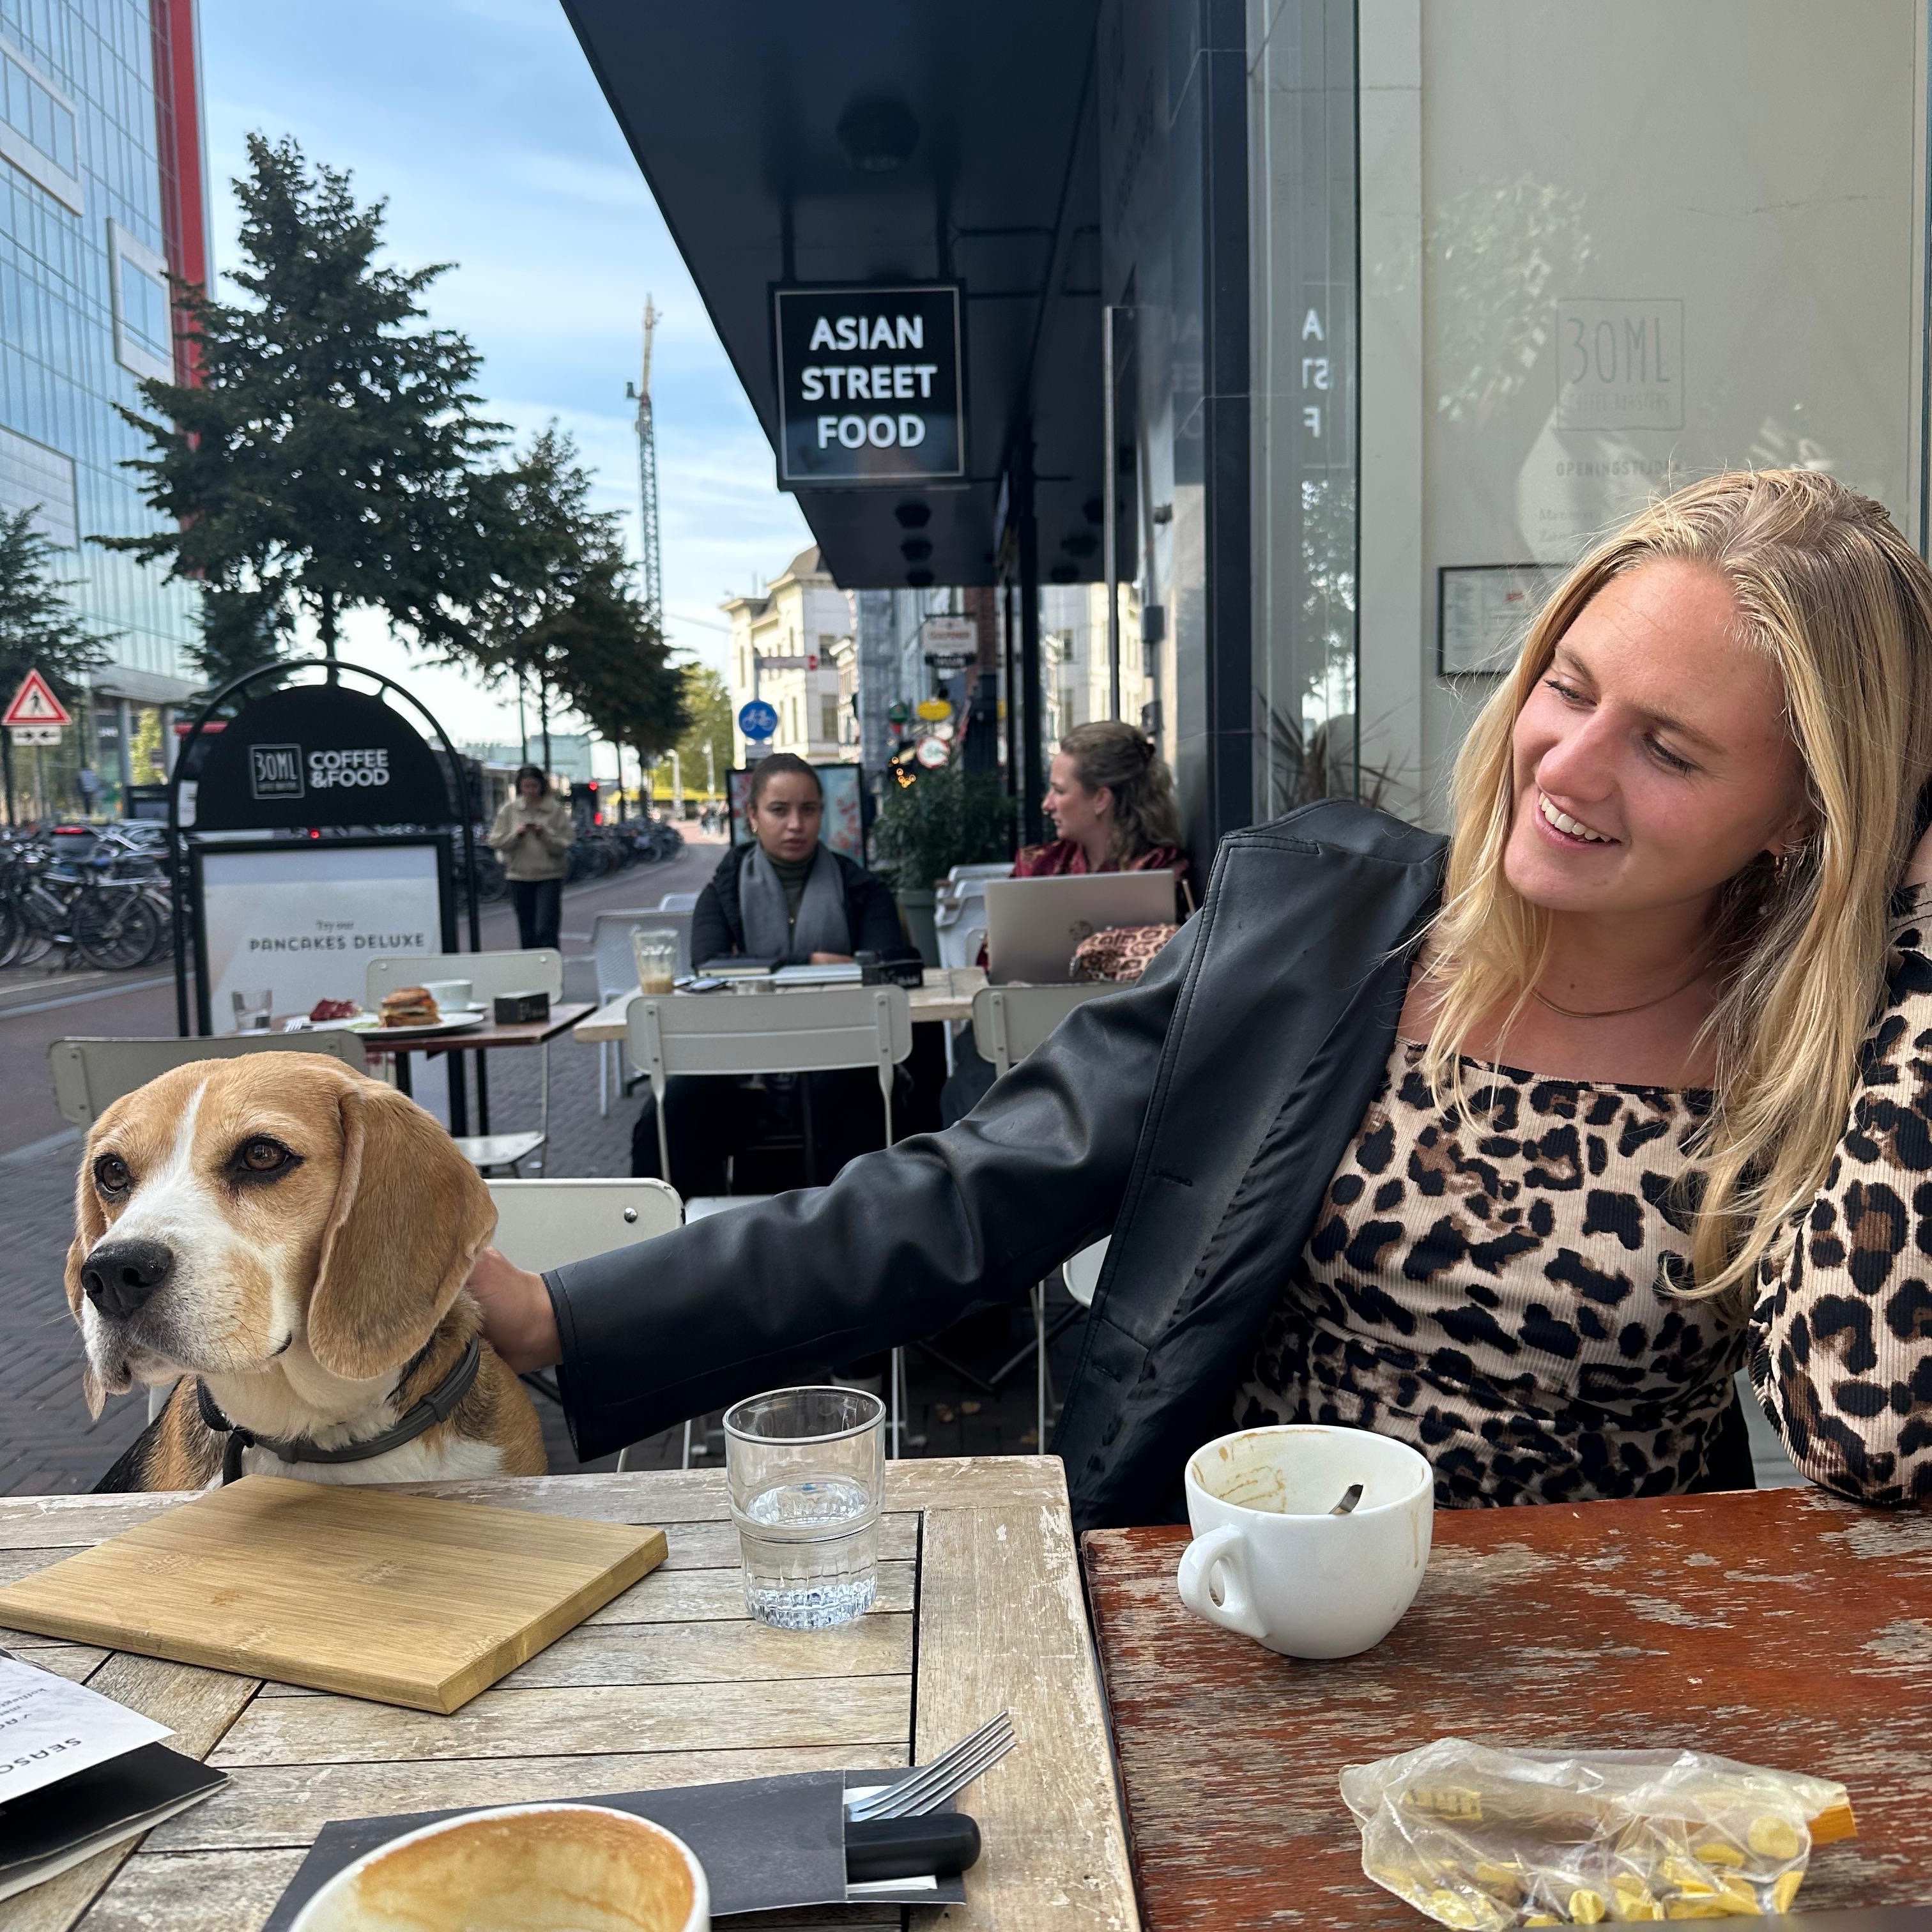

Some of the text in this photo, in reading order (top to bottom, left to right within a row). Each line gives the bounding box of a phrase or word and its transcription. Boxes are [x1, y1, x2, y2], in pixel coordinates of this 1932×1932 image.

[809, 315, 924, 351] ASIAN
[1567, 317, 1671, 384] 30ML
[801, 364, 938, 401] STREET
[817, 413, 926, 449] FOOD
[255, 751, 298, 781] 30ML
[309, 748, 388, 770] COFFEE
[310, 768, 390, 789] &FOOD
[249, 933, 424, 951] PANCAKES DELUXE
